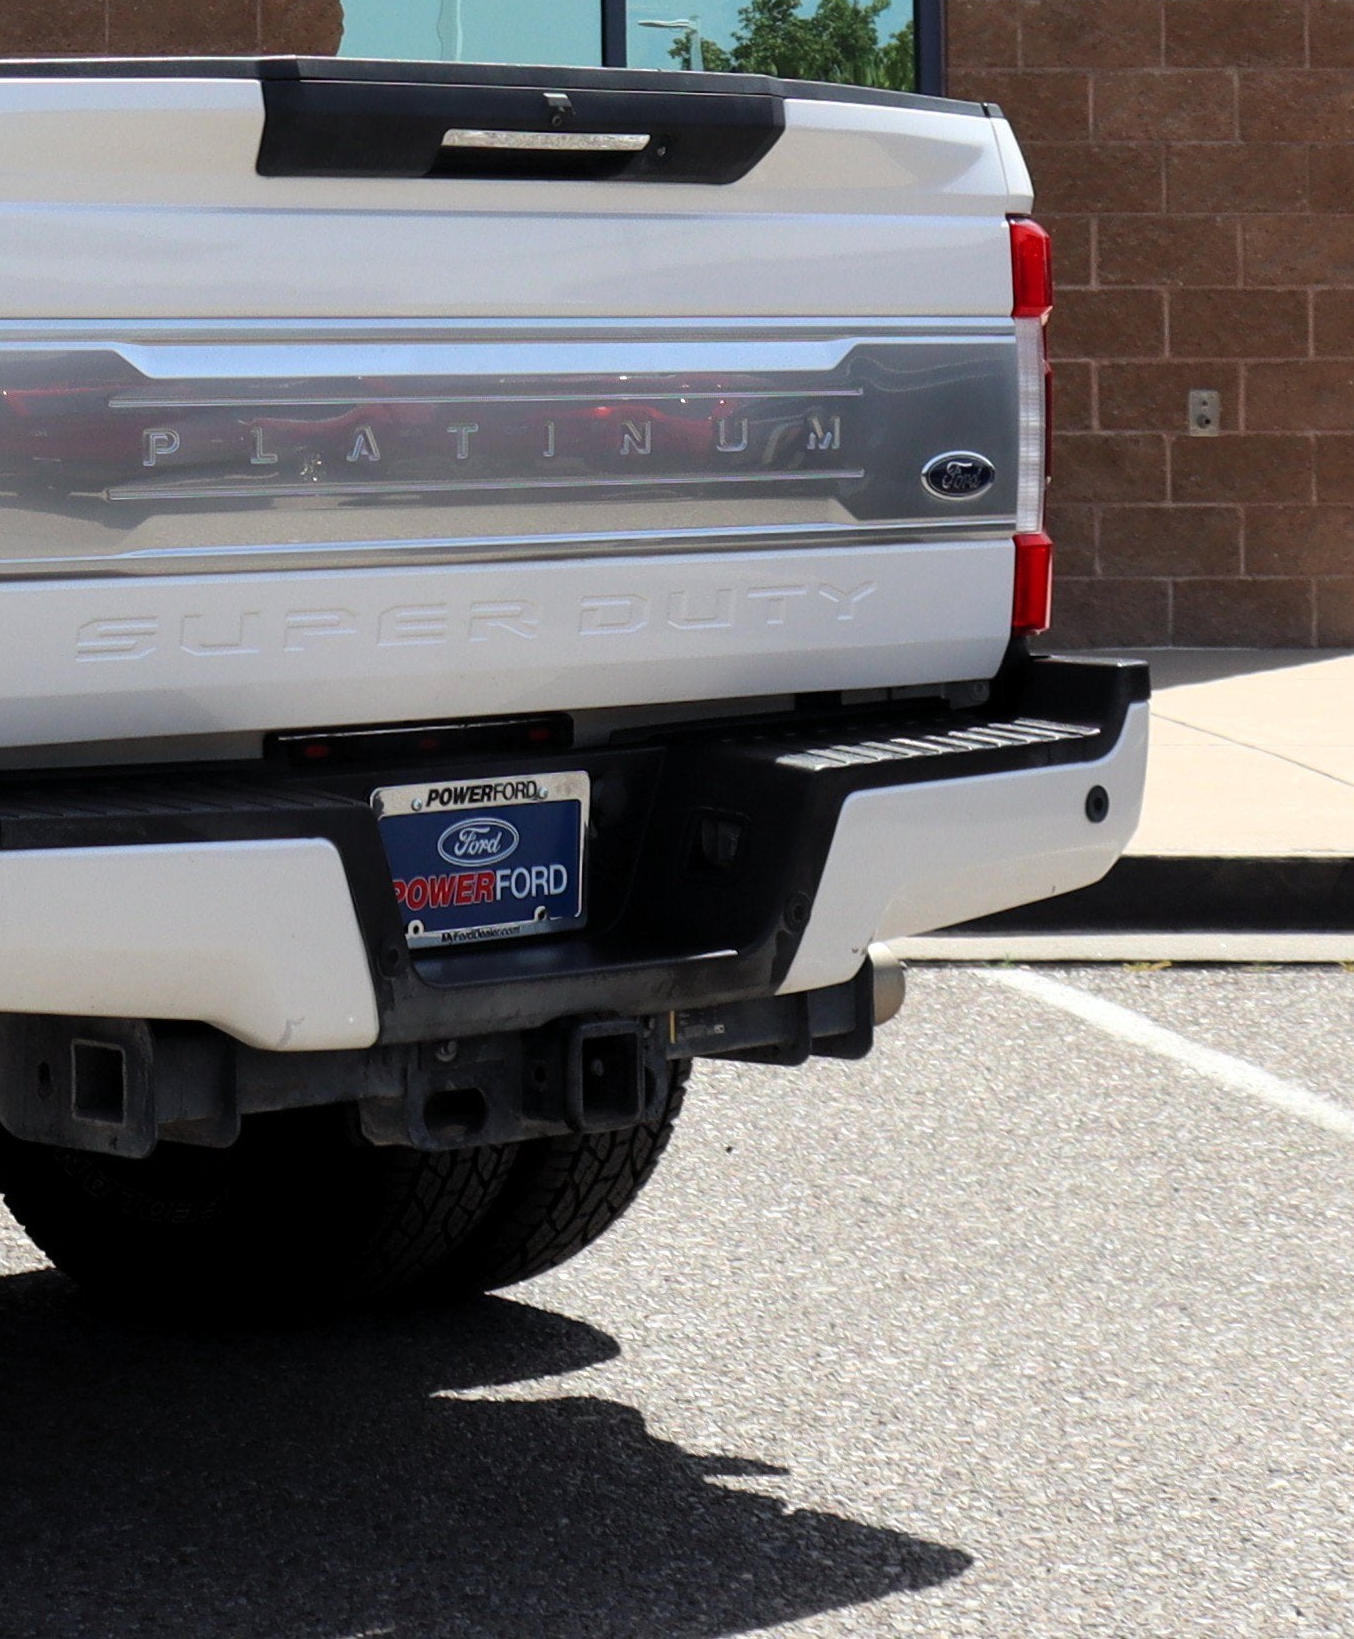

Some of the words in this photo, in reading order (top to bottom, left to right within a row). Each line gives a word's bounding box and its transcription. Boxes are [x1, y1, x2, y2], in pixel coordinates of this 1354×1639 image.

[142, 415, 842, 468] PLATINUM
[941, 462, 983, 489] Ford
[74, 598, 539, 663] SUPER
[578, 580, 878, 638] DUTY
[426, 780, 537, 807] POWERFORD
[454, 827, 503, 856] Ford
